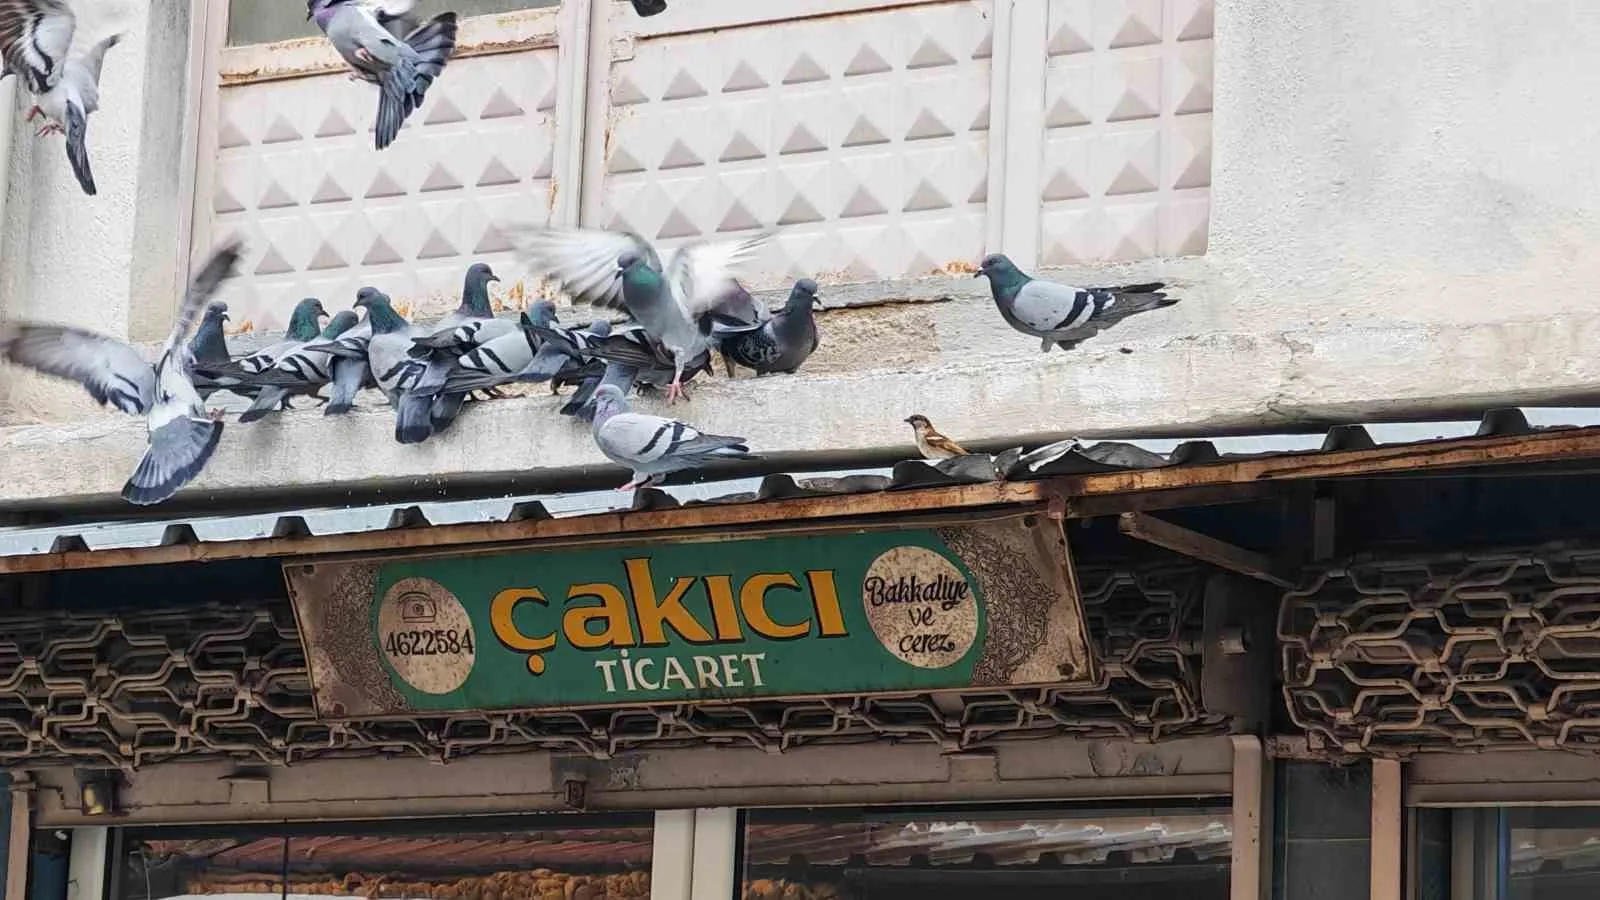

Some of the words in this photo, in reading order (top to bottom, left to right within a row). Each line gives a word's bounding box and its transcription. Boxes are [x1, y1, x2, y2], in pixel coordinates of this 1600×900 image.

[865, 573, 969, 611] Bakkaliye
[908, 607, 937, 627] ve
[385, 629, 474, 656] 4622584
[595, 648, 766, 693] TİCARET
